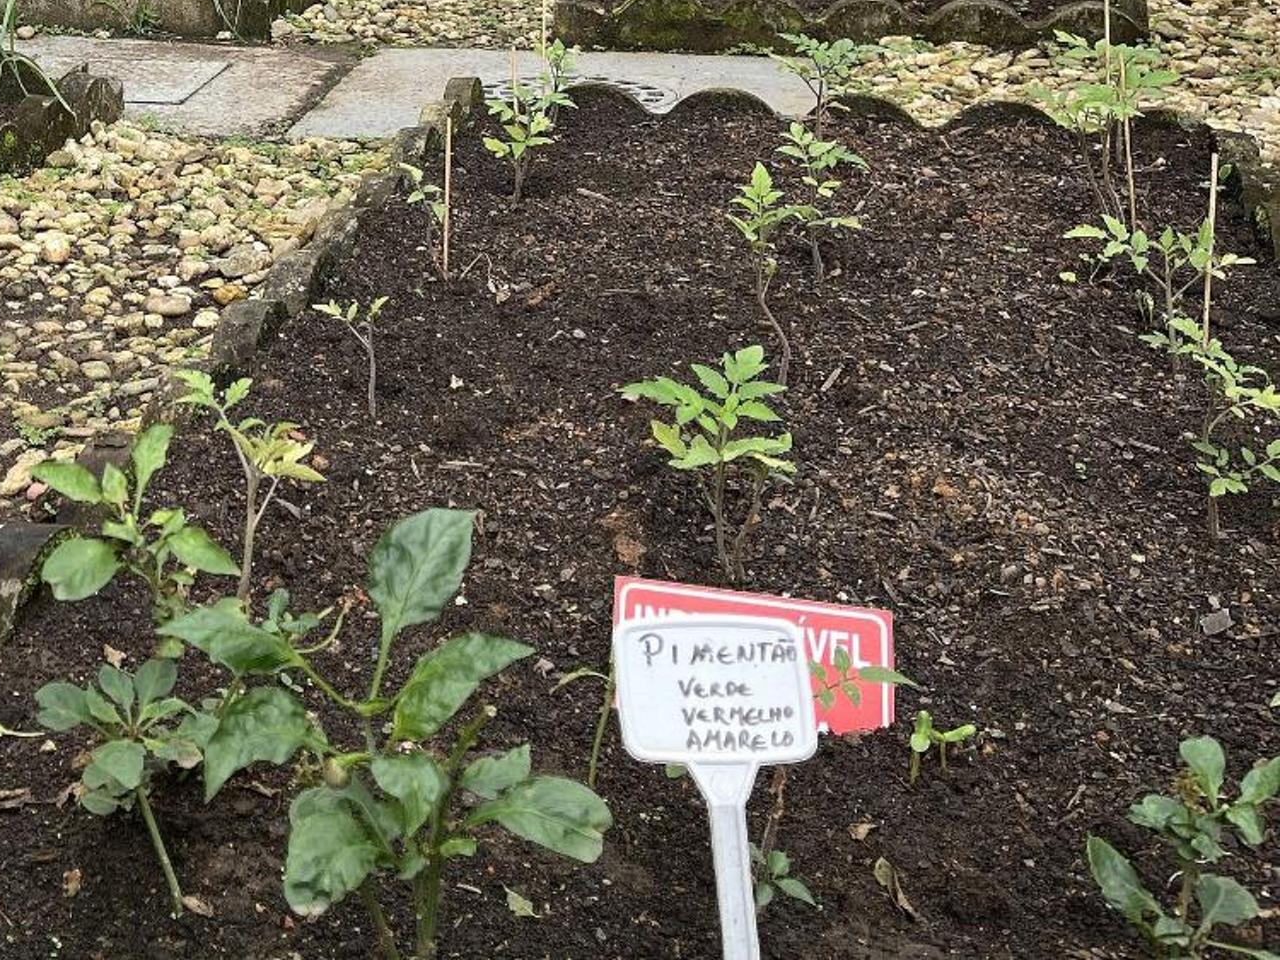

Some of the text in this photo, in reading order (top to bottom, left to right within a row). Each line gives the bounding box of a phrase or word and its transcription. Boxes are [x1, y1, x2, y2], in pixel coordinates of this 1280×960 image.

[638, 632, 797, 667] PIMENTÃO
[678, 676, 753, 698] VERDE
[682, 706, 794, 727] VERMELHO
[686, 730, 794, 752] AMARELO
